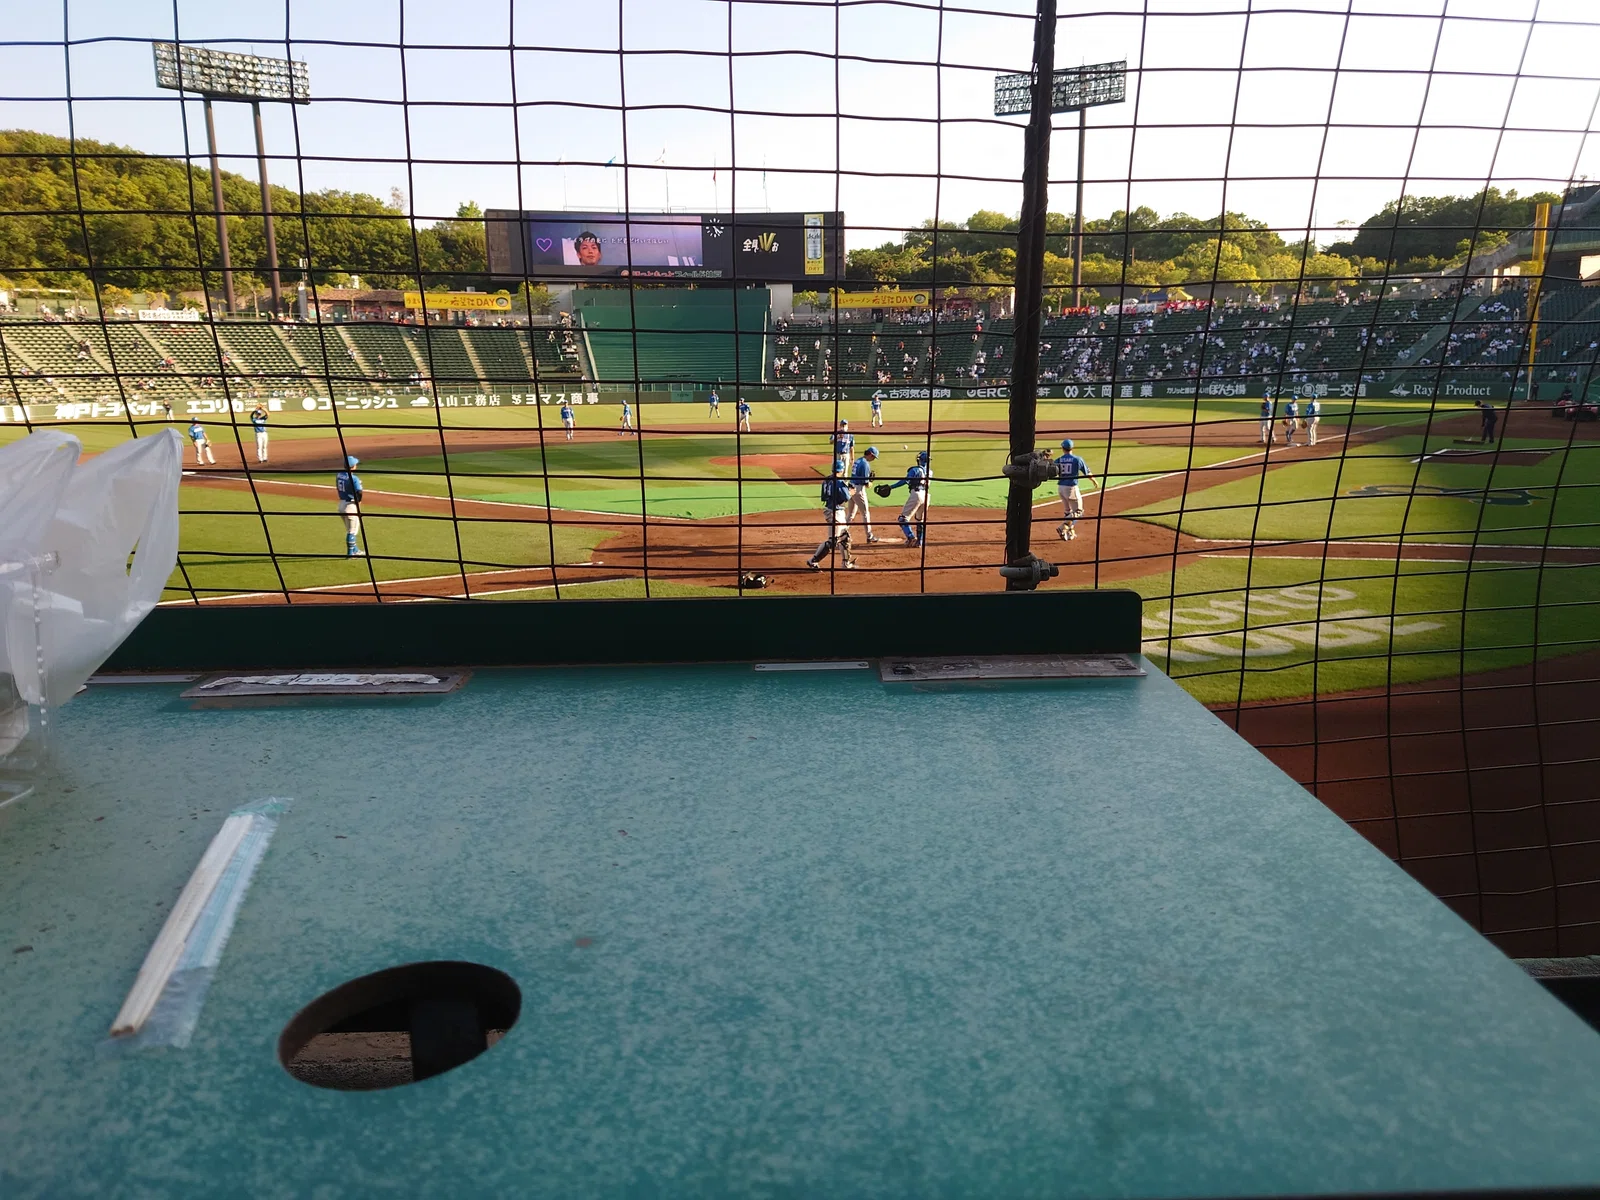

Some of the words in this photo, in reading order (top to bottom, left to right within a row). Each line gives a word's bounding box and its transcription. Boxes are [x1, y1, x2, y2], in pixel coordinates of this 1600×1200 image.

[1083, 385, 1153, 398] 大岡産業
[1413, 384, 1439, 397] Rays
[1446, 383, 1491, 396] Product
[186, 399, 244, 413] エコリカ
[317, 397, 399, 410] コーニッシュ
